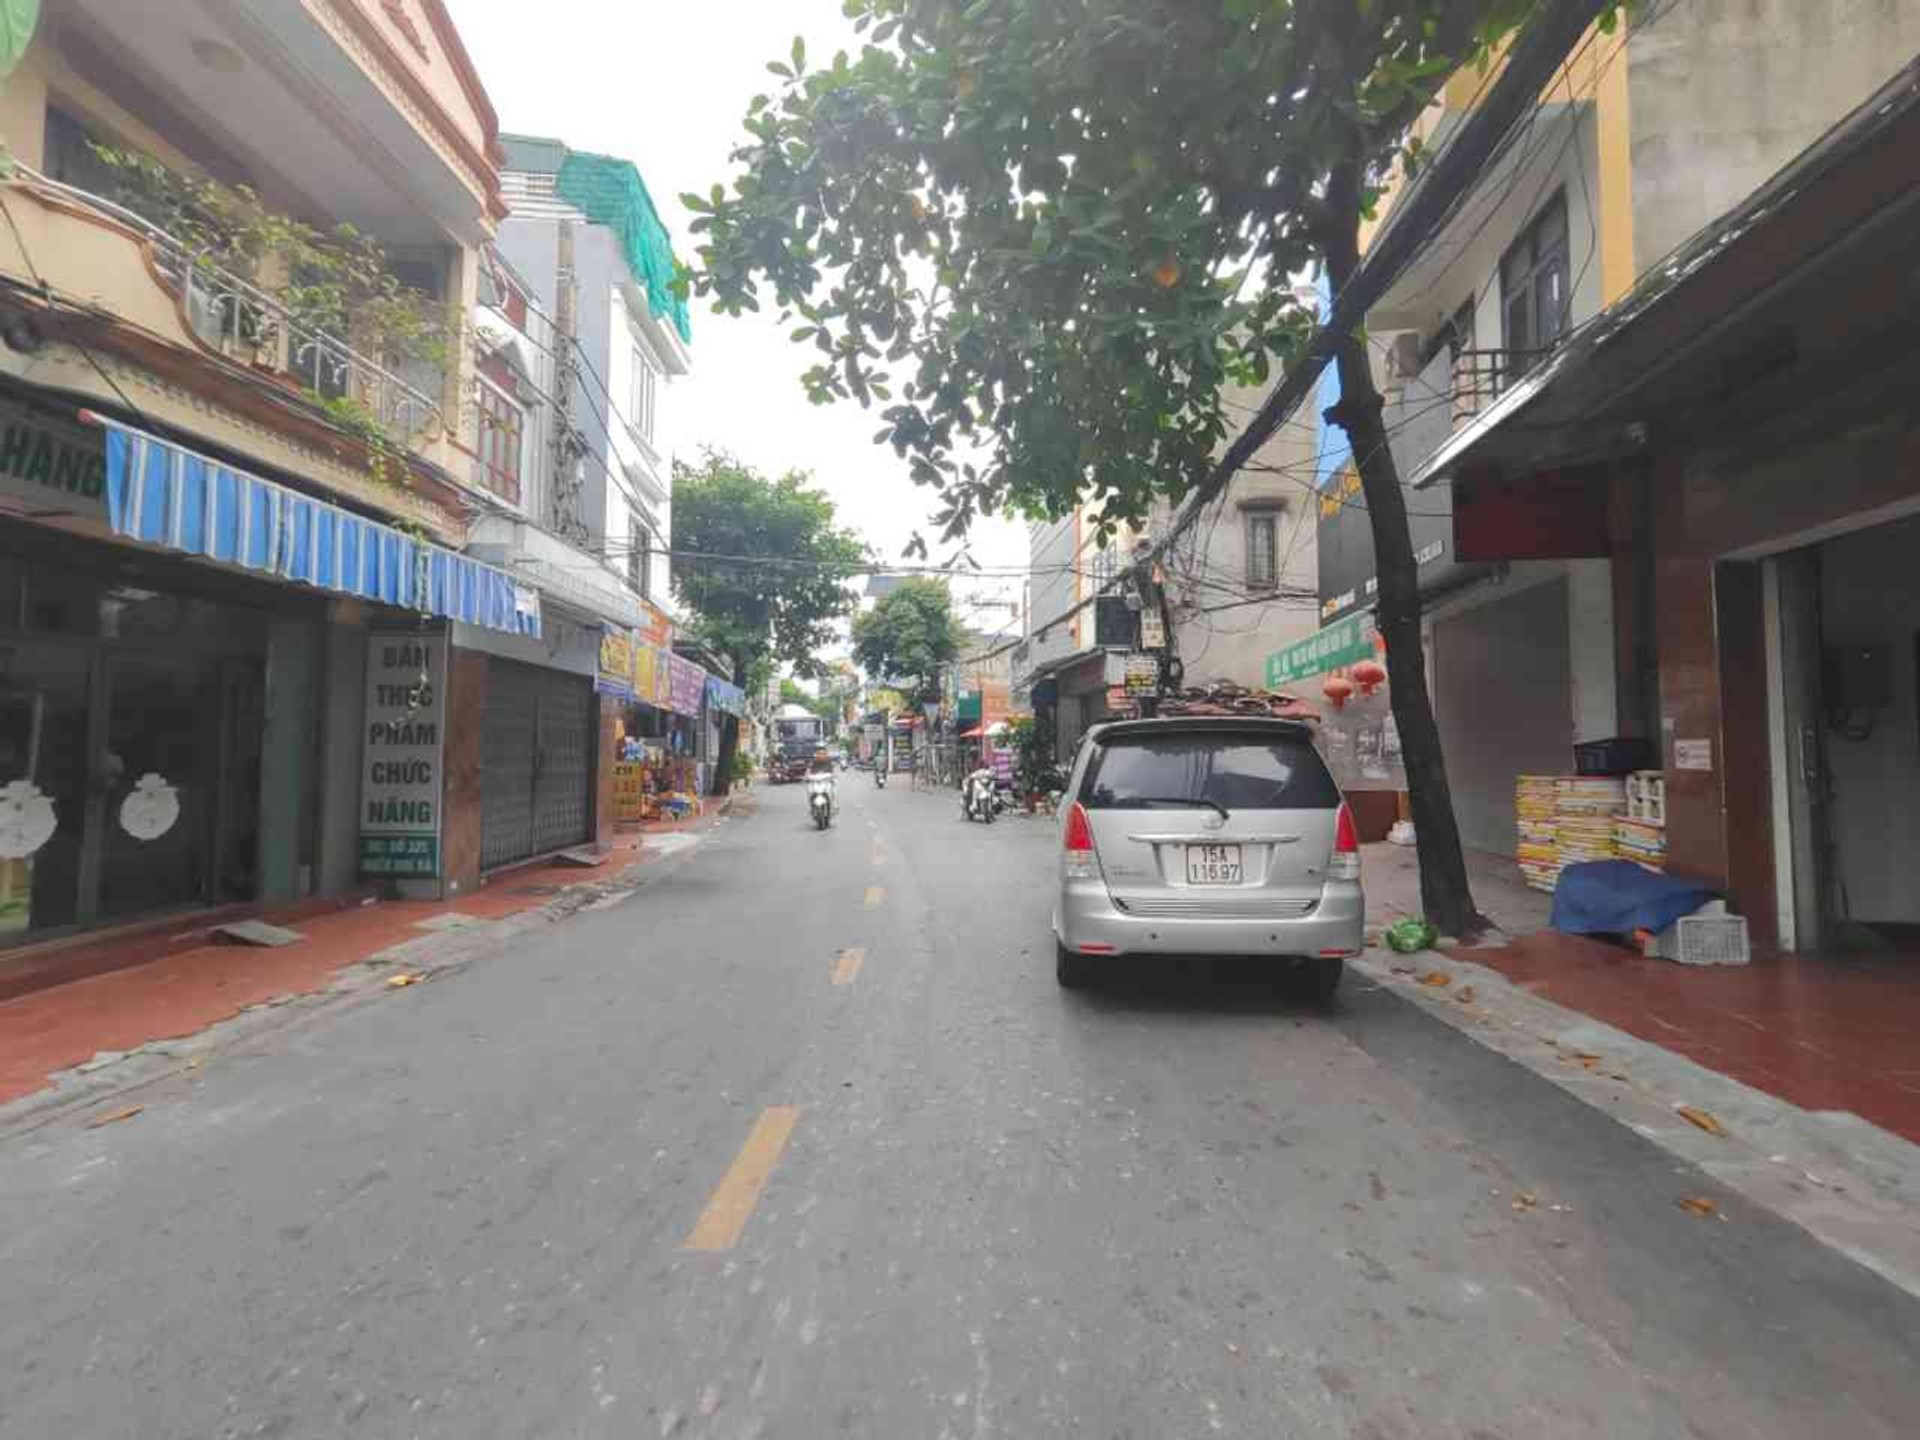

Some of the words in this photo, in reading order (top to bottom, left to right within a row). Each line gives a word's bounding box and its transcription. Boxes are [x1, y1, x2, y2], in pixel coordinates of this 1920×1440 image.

[371, 757, 431, 784] CHỨC
[367, 797, 431, 823] NĂNG
[1202, 846, 1227, 863] 15A
